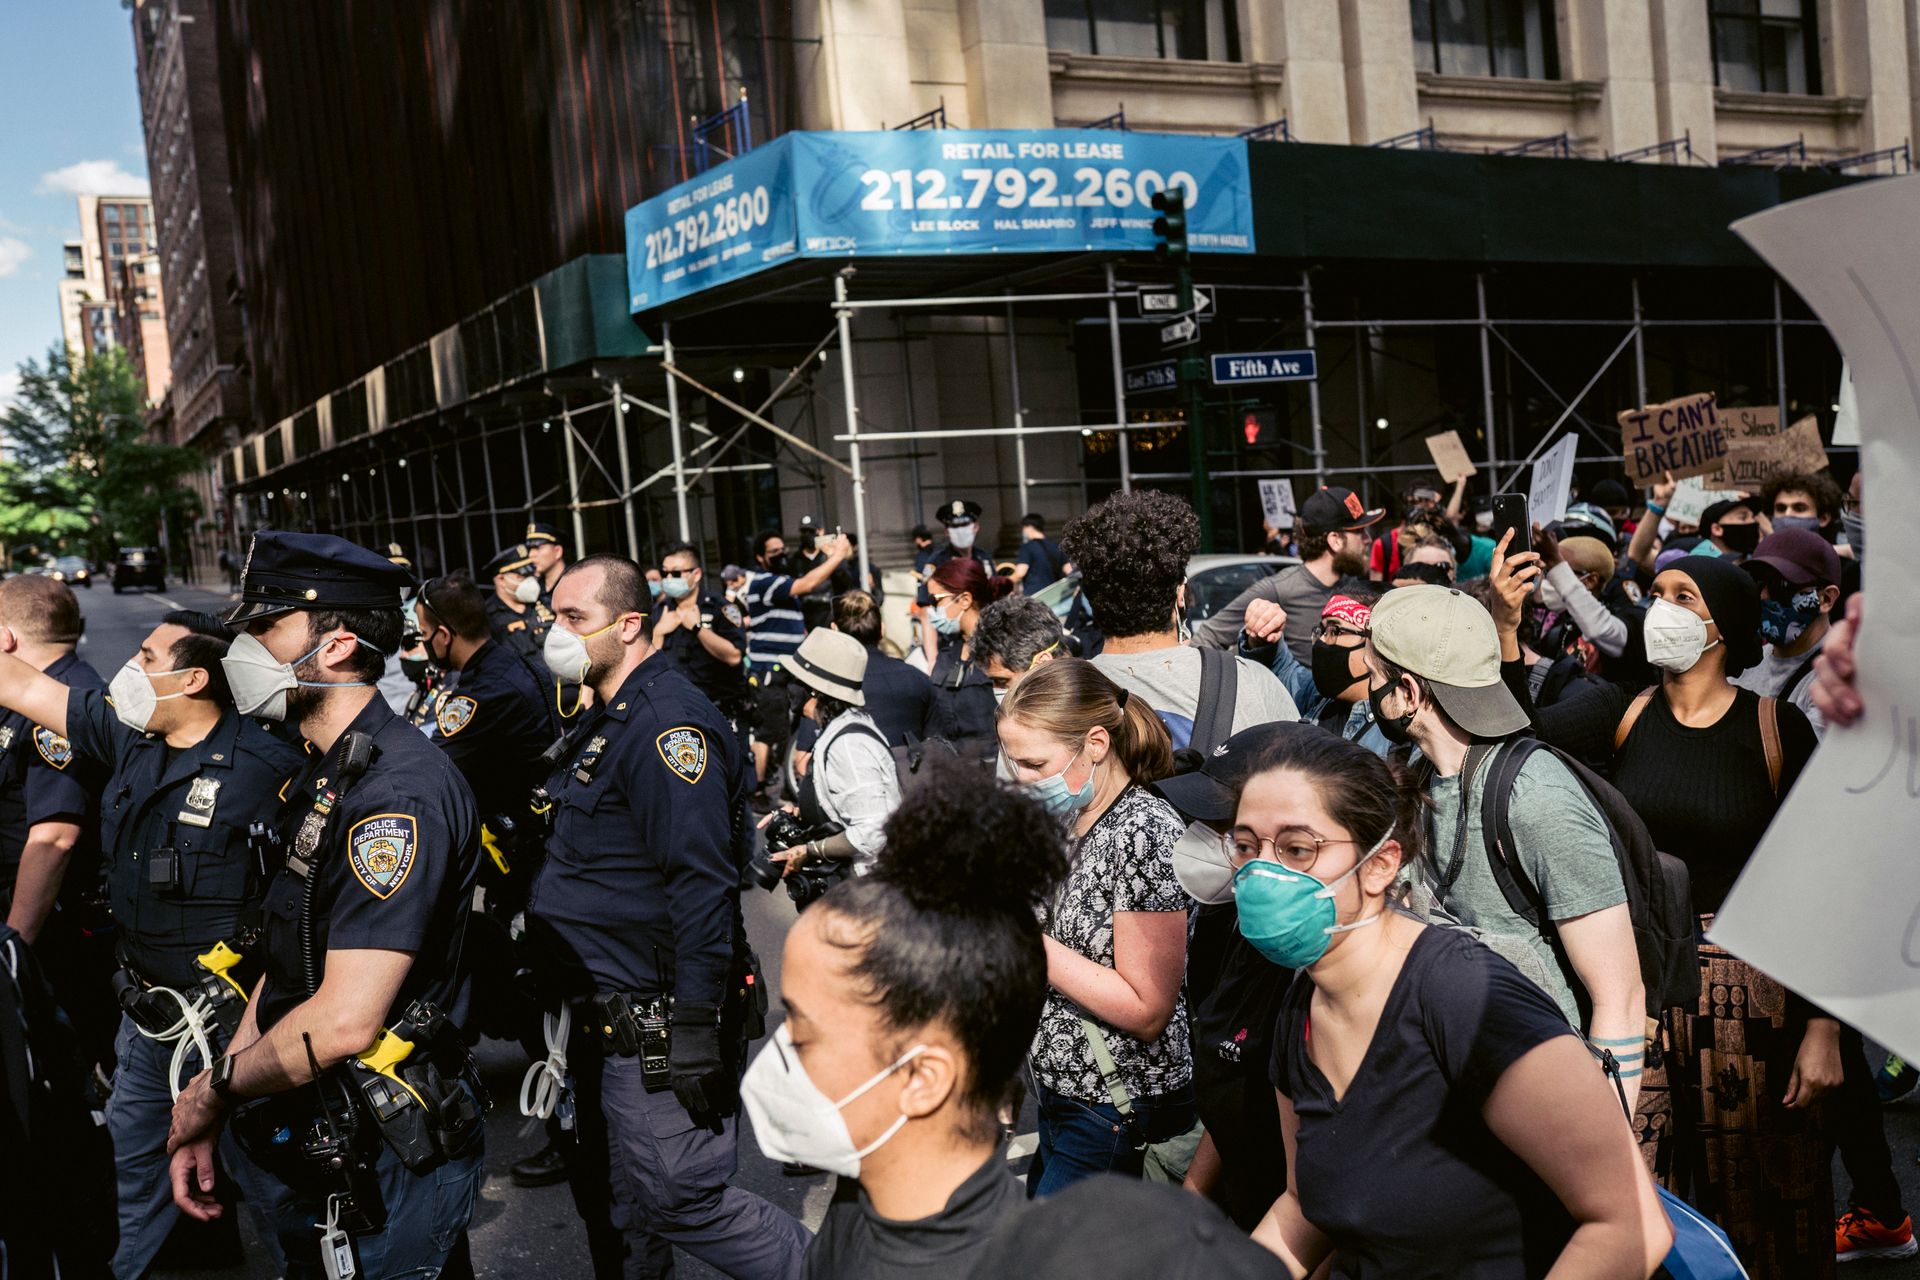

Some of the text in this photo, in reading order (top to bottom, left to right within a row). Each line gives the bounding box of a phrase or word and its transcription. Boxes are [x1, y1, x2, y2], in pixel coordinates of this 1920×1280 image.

[942, 143, 1124, 160] RETAIL FOR LEASE
[859, 167, 1199, 211] 212.792.2600
[645, 185, 770, 269] 212.792.2600
[911, 219, 936, 232] LEE
[937, 219, 980, 232] BLOCK
[993, 219, 1019, 231] HAL
[1022, 218, 1077, 230] SHAPIRO
[1090, 217, 1118, 229] JEFF
[1229, 358, 1301, 378] Fifth Ave
[1628, 414, 1654, 444] I
[1741, 411, 1777, 438] Silence
[1634, 427, 1728, 479] BREATHE
[664, 736, 700, 751] DEPARTMENT
[670, 731, 691, 741] POLICE
[667, 755, 687, 774] CITY OF
[365, 820, 397, 832] POLICE
[353, 828, 410, 847] DEPARTMENT
[353, 855, 378, 886] CITY OF
[389, 843, 413, 888] NEW YORK
